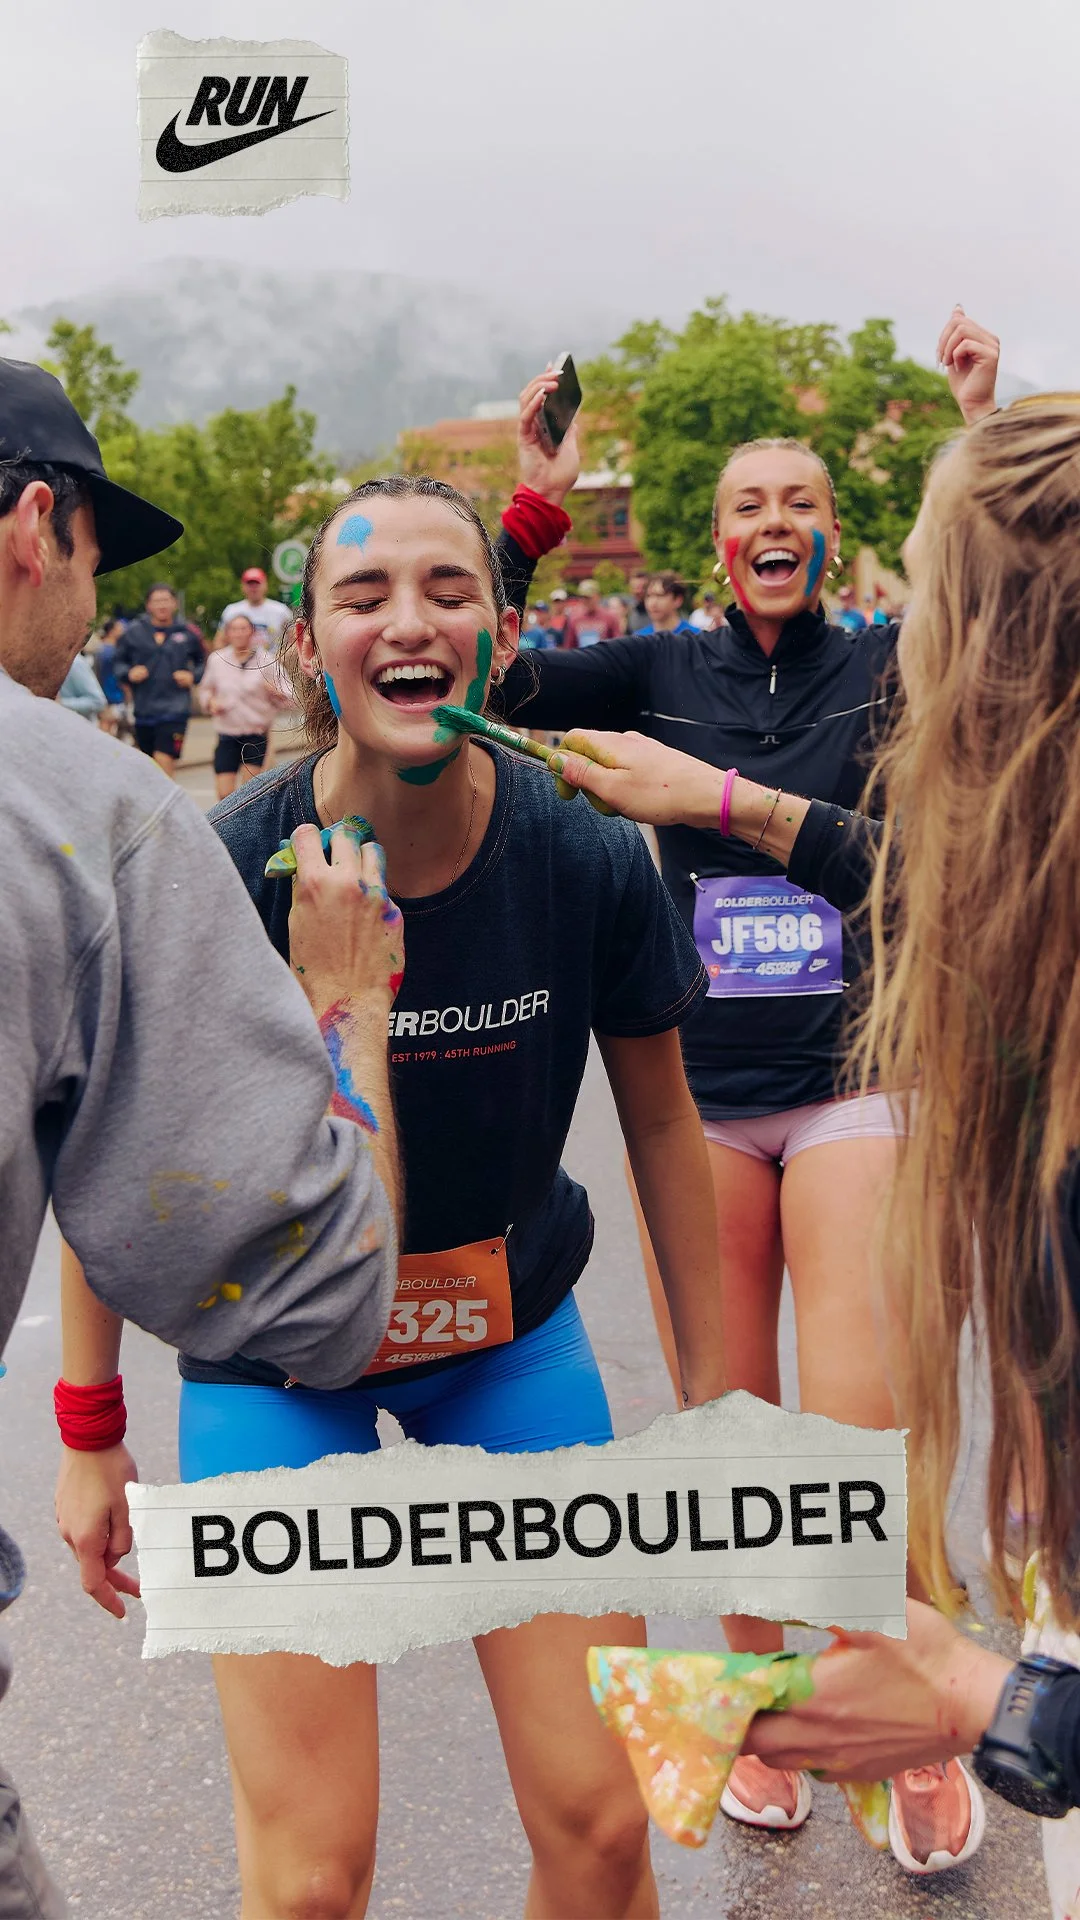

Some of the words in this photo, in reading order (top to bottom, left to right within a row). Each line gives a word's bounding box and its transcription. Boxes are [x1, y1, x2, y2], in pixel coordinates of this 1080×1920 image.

[715, 895, 814, 908] BOLDERBOULDER
[711, 913, 823, 955] JF586
[391, 1053, 411, 1062] EST
[414, 1050, 437, 1061] 1979
[445, 1049, 470, 1059] 45TH
[473, 1041, 517, 1056] RUNNING
[387, 1299, 488, 1344] 325
[385, 1354, 414, 1363] 45
